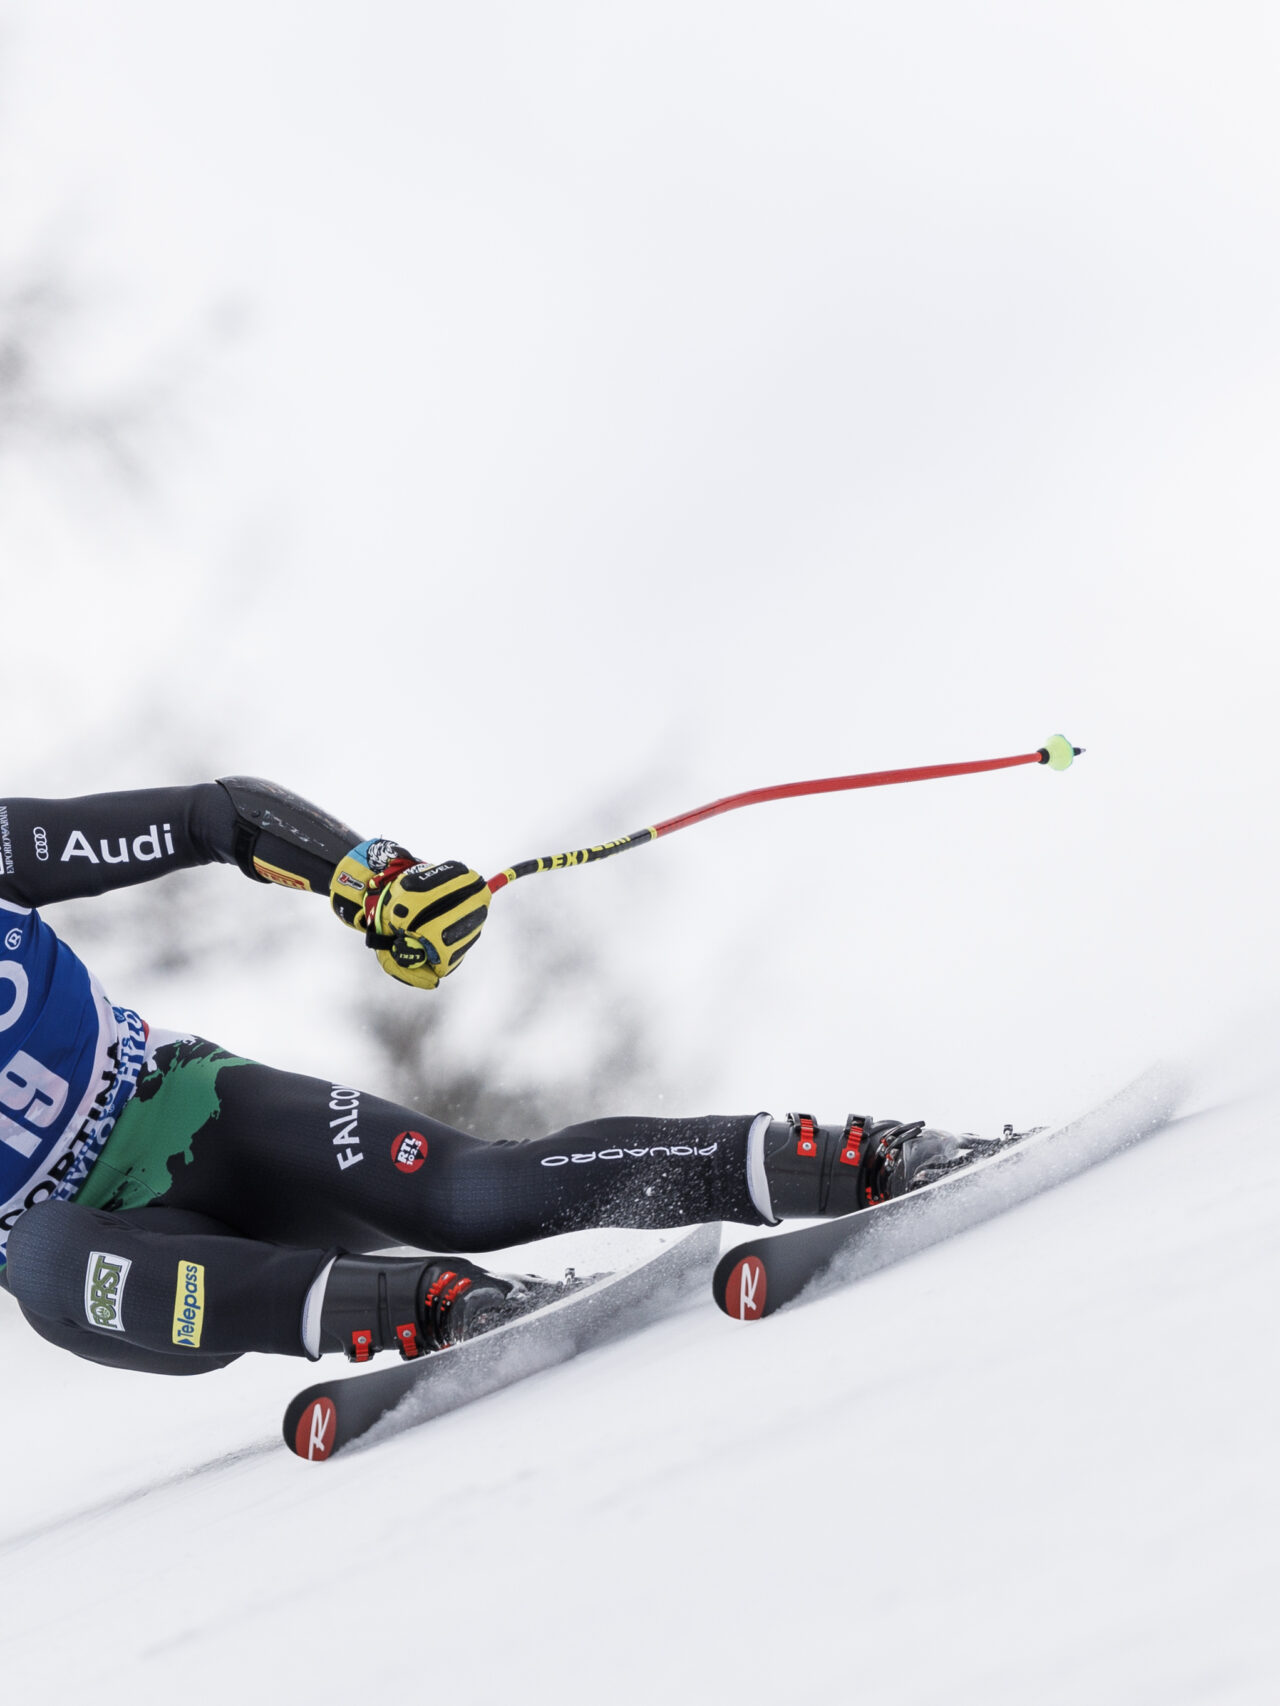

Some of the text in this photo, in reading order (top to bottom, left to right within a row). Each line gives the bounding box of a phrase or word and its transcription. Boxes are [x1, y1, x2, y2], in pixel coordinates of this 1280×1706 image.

[60, 823, 175, 864] Audi
[418, 864, 455, 881] LEVEL
[397, 1138, 416, 1164] RTL
[406, 1140, 422, 1166] 102.5
[541, 1142, 718, 1167] PIQUADRO
[90, 1255, 122, 1329] FORST
[177, 1264, 201, 1338] Telepass
